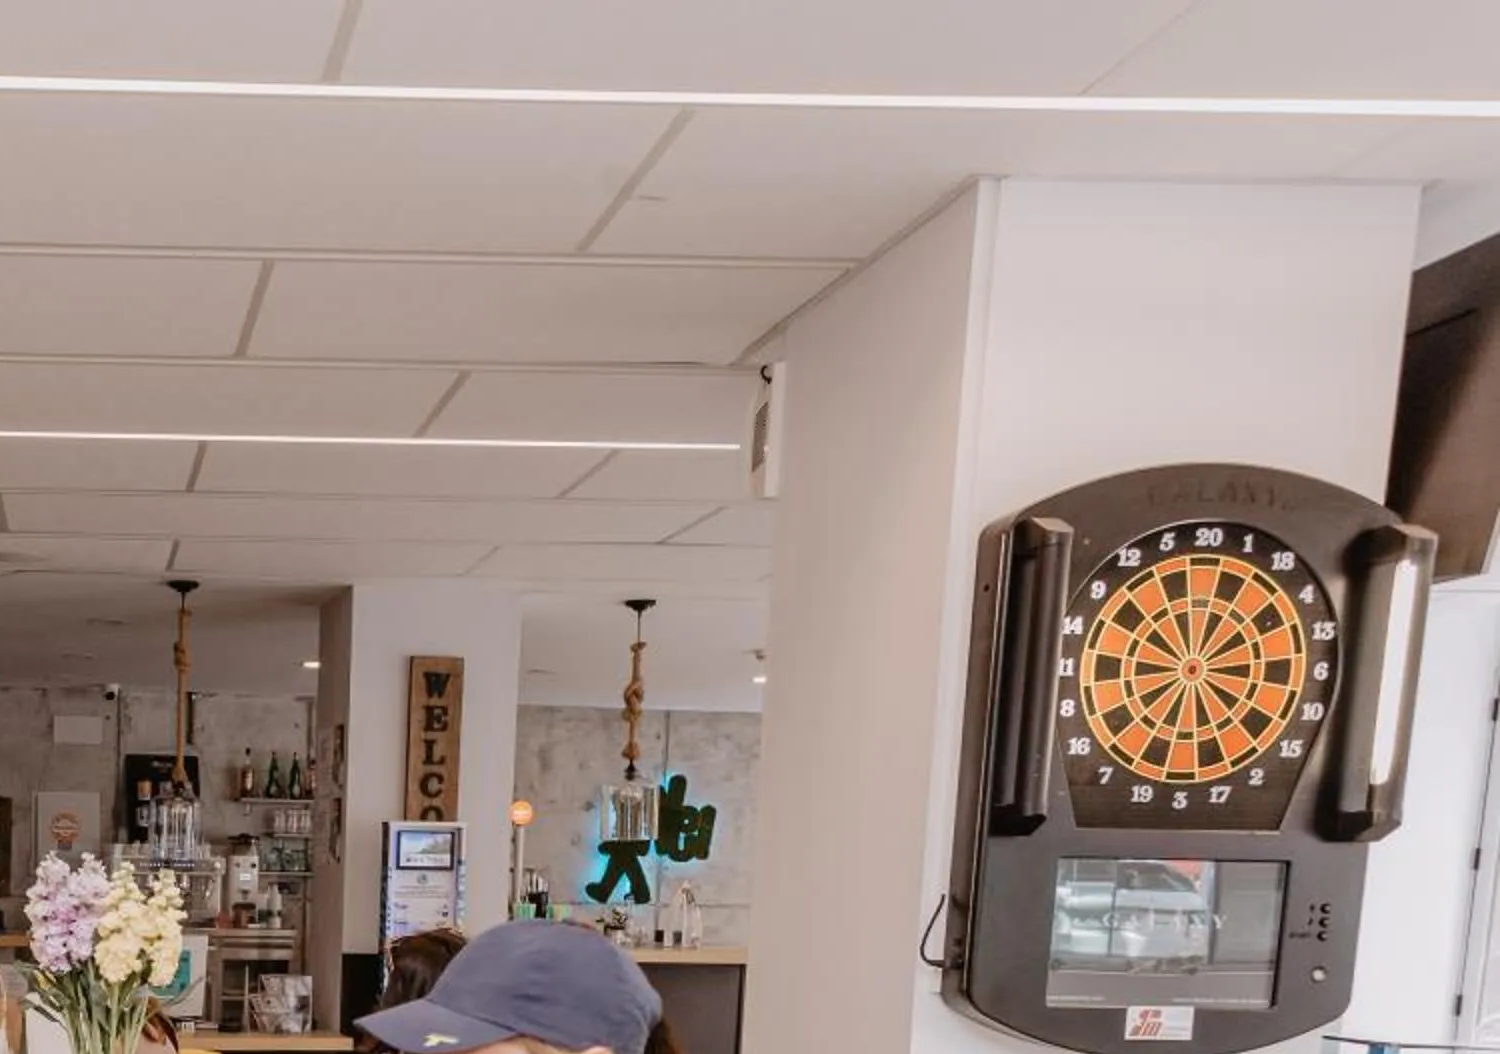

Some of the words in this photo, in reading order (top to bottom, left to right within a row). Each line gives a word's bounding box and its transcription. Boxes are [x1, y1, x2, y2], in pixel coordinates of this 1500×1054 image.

[1159, 533, 1175, 551] 5
[1194, 528, 1223, 547] 20
[1243, 534, 1254, 552] 1
[1117, 547, 1141, 567] 12
[1271, 551, 1295, 571] 18
[1090, 580, 1107, 600] 9
[1299, 584, 1315, 604] 4
[1311, 621, 1335, 641] 13
[1313, 661, 1330, 682] 6
[1060, 698, 1076, 718] 8
[1301, 702, 1324, 721] 10
[1067, 736, 1091, 755] 16
[1279, 739, 1303, 758] 15
[1098, 766, 1114, 785] 7
[1248, 768, 1264, 786] 2
[1131, 784, 1154, 803] 19
[1171, 790, 1188, 809] 3
[1208, 785, 1232, 804] 17
